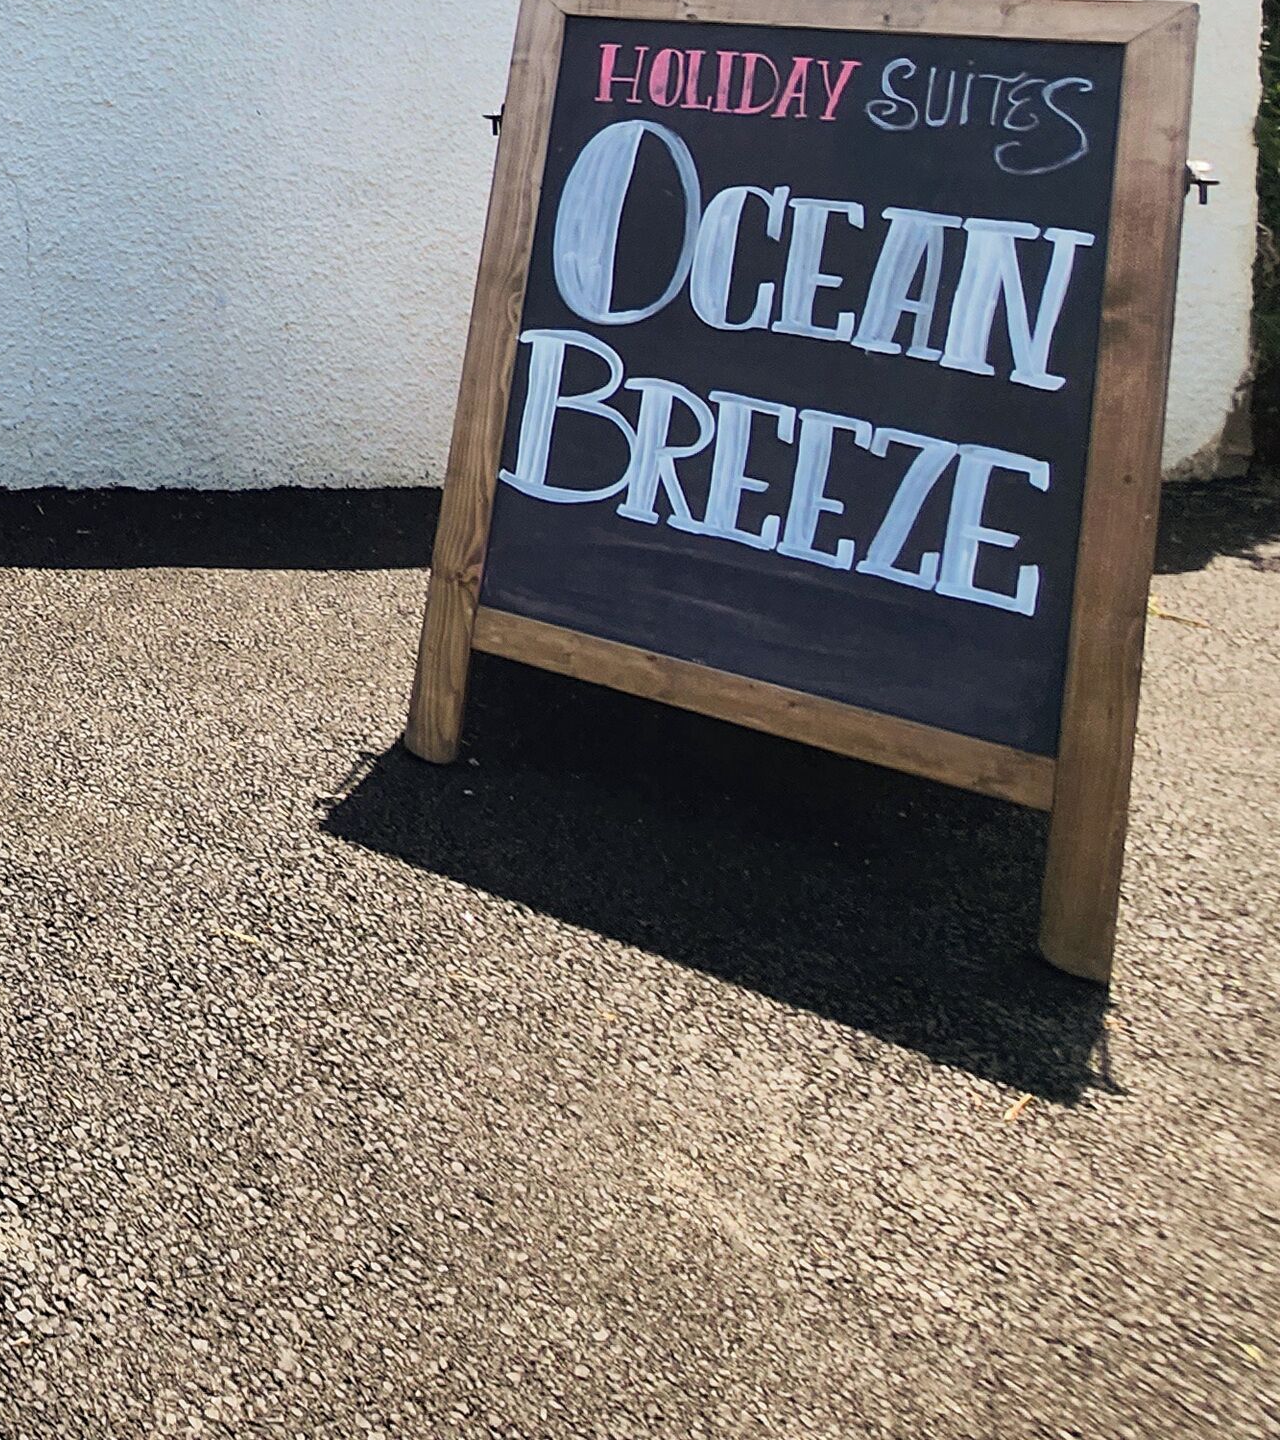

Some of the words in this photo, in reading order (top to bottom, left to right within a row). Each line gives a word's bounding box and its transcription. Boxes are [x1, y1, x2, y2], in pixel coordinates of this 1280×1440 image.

[594, 43, 862, 121] HOLIDAY
[553, 119, 1095, 391] OCEAN
[499, 329, 1050, 617] BREEZE
